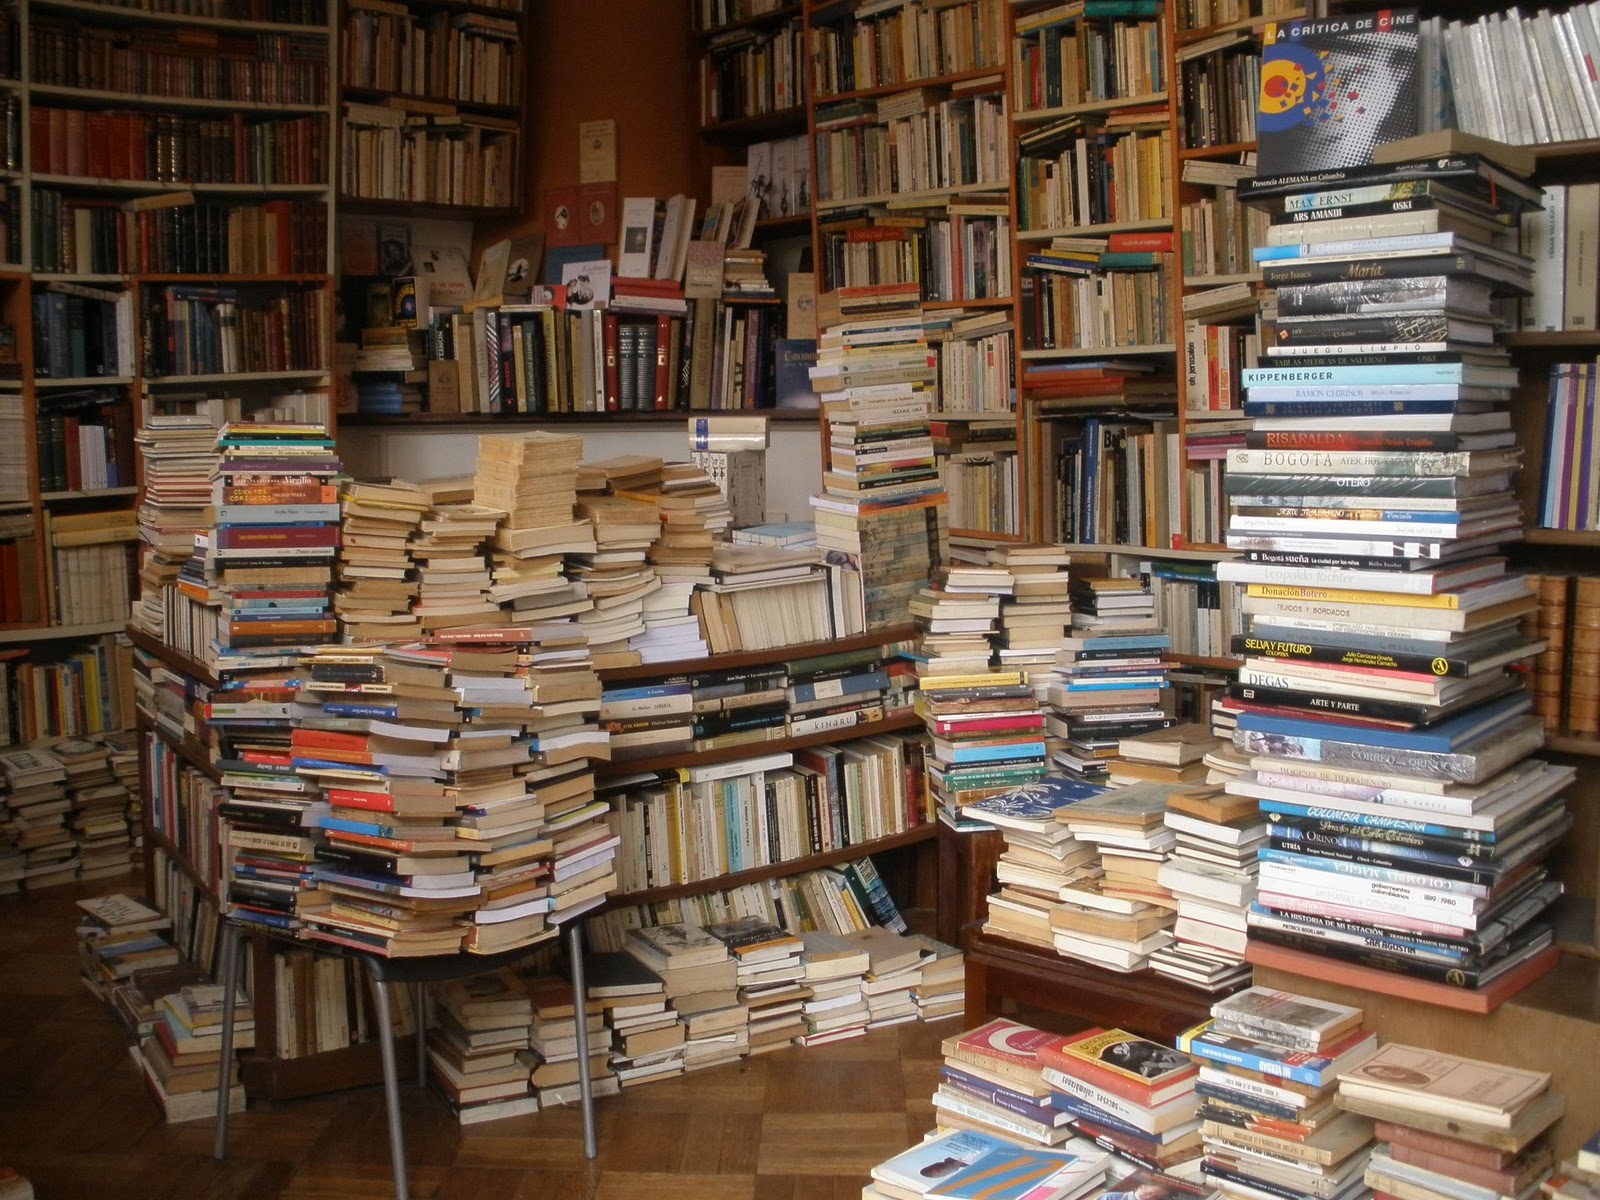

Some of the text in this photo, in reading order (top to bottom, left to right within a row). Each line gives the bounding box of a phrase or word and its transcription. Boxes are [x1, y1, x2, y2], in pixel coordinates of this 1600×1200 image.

[1267, 14, 1414, 40] LA CRÍTICA DE CINE
[1252, 178, 1277, 187] Presencia
[1277, 175, 1309, 185] ALEMANA
[1318, 172, 1345, 180] Colombia
[1290, 193, 1354, 210] MAX ERNST
[1294, 200, 1412, 221] ARS AMANDI OSKI
[1270, 272, 1289, 281] Jorge
[1290, 270, 1312, 279] Isaacs
[1360, 344, 1421, 352] LIMPIO
[1274, 358, 1302, 366] TABLAS
[1337, 357, 1348, 365] DE
[1349, 355, 1387, 365] SALERNO
[1248, 371, 1333, 381] KIPPENBERGER
[1295, 388, 1364, 398] RAMÓN CHIRINOS
[1267, 432, 1345, 444] RISARALDA
[1264, 452, 1333, 467] BOGOTA
[281, 475, 313, 486] Virgilio
[1336, 477, 1371, 487] OTERO
[1262, 553, 1284, 563] Bogotá
[1285, 554, 1309, 563] sueña
[1264, 569, 1355, 583] Leopoldo Richter
[1277, 603, 1303, 612] TEJIDOS
[1312, 607, 1350, 617] BORDADOS
[1245, 638, 1269, 650] SELVA
[1277, 642, 1313, 655] FUTURO
[1249, 673, 1289, 688] DEGAS
[1310, 698, 1328, 707] ARTE
[1337, 701, 1360, 711] PARTE
[1351, 750, 1395, 763] CORREO
[1307, 806, 1426, 832] COLOMBIA CAMPESINA
[1281, 841, 1301, 851] UTRÍA
[1371, 882, 1411, 894] gobernantes
[1440, 897, 1457, 906] 1980
[1371, 889, 1410, 900] colombianos
[1290, 913, 1324, 926] HISTORIA
[1325, 919, 1336, 927] DE
[1347, 924, 1384, 937] ESTACIÓN
[1061, 1076, 1119, 1111] sucesos colombianos
